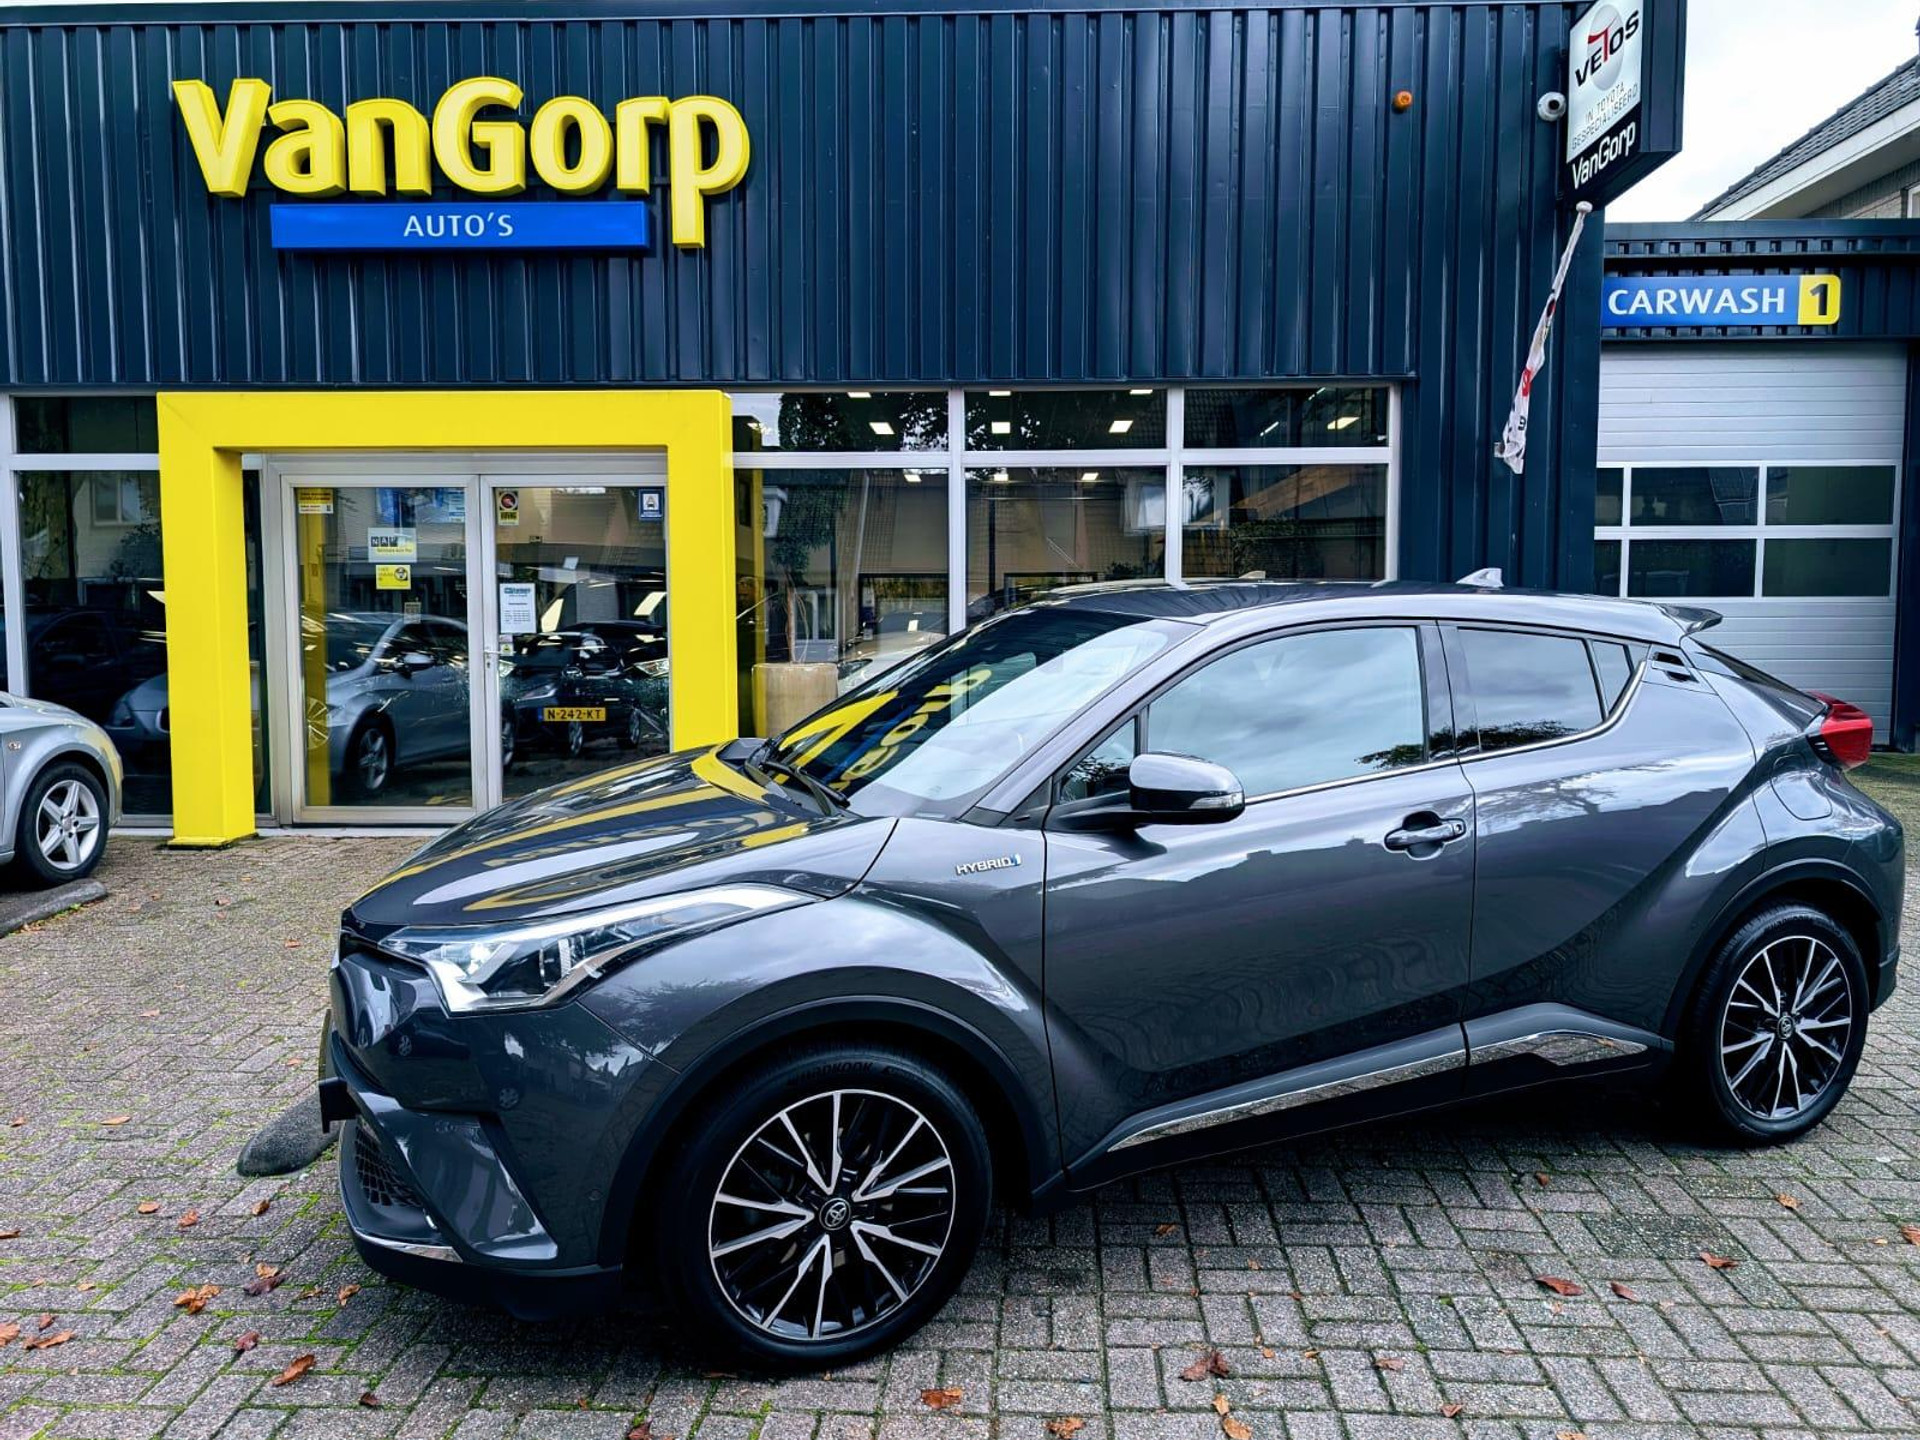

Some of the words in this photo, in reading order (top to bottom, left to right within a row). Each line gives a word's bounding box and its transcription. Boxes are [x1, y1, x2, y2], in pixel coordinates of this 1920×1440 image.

[1597, 82, 1625, 115] TOYOTA
[171, 75, 751, 250] VanGorp
[1572, 121, 1636, 190] VanGorp
[403, 212, 514, 238] AUTO'S
[1608, 288, 1785, 315] CARWASH
[1809, 283, 1829, 316] 1
[547, 709, 602, 720] N-242-KT
[956, 856, 1014, 875] HYBRID
